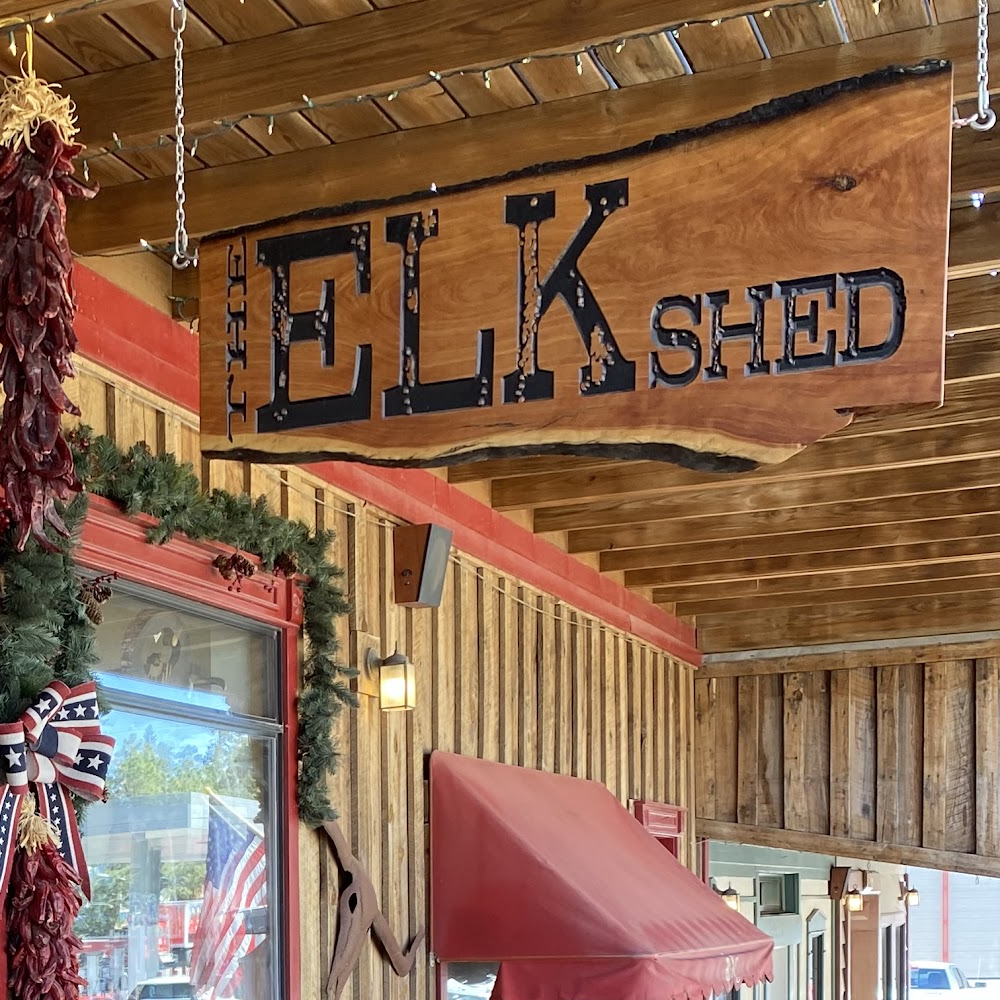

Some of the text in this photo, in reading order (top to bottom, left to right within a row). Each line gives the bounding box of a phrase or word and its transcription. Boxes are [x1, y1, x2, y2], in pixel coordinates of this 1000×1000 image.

[226, 236, 247, 443] THE
[256, 177, 907, 433] ELK SHED
